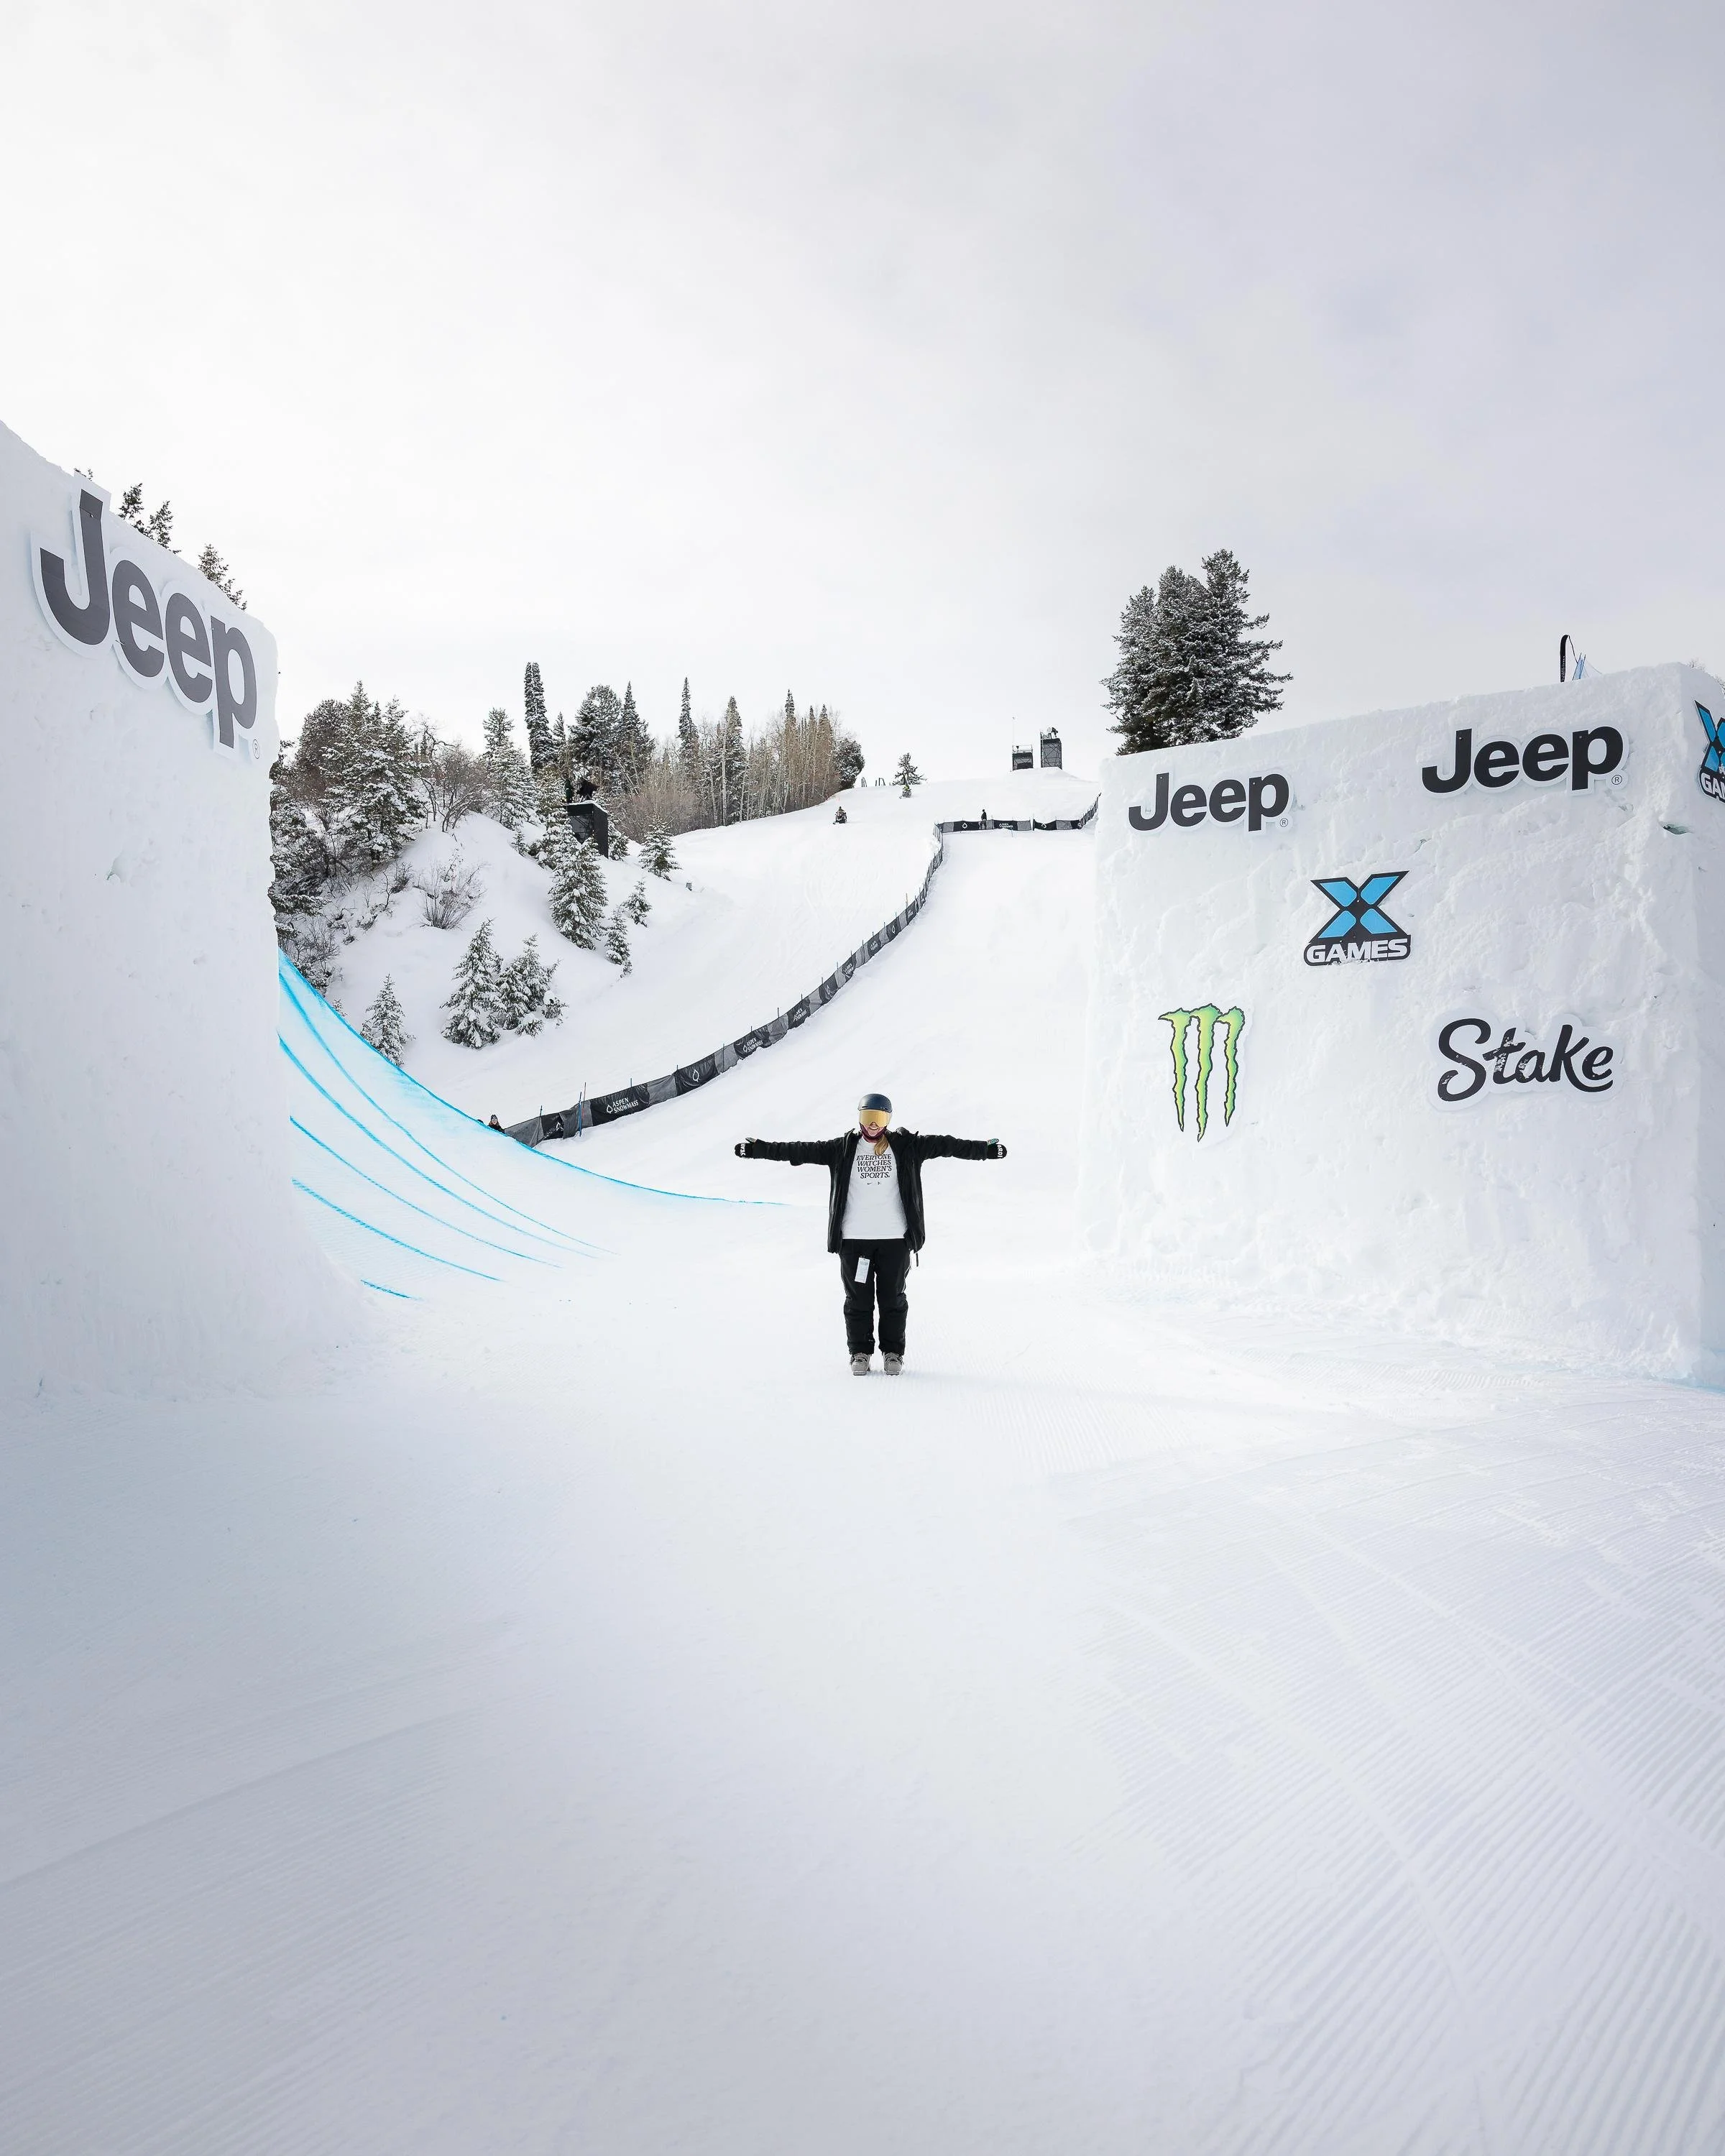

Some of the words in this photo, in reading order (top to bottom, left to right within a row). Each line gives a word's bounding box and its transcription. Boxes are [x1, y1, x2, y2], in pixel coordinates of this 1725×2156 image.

[40, 489, 257, 749] Jeep
[1422, 726, 1624, 791] Jeep
[1128, 772, 1289, 831] Jeep
[1306, 938, 1408, 964] GAMES
[1438, 1018, 1614, 1102] Stake
[612, 1097, 629, 1107] ASPEN
[613, 1100, 639, 1113] SNOWMASS
